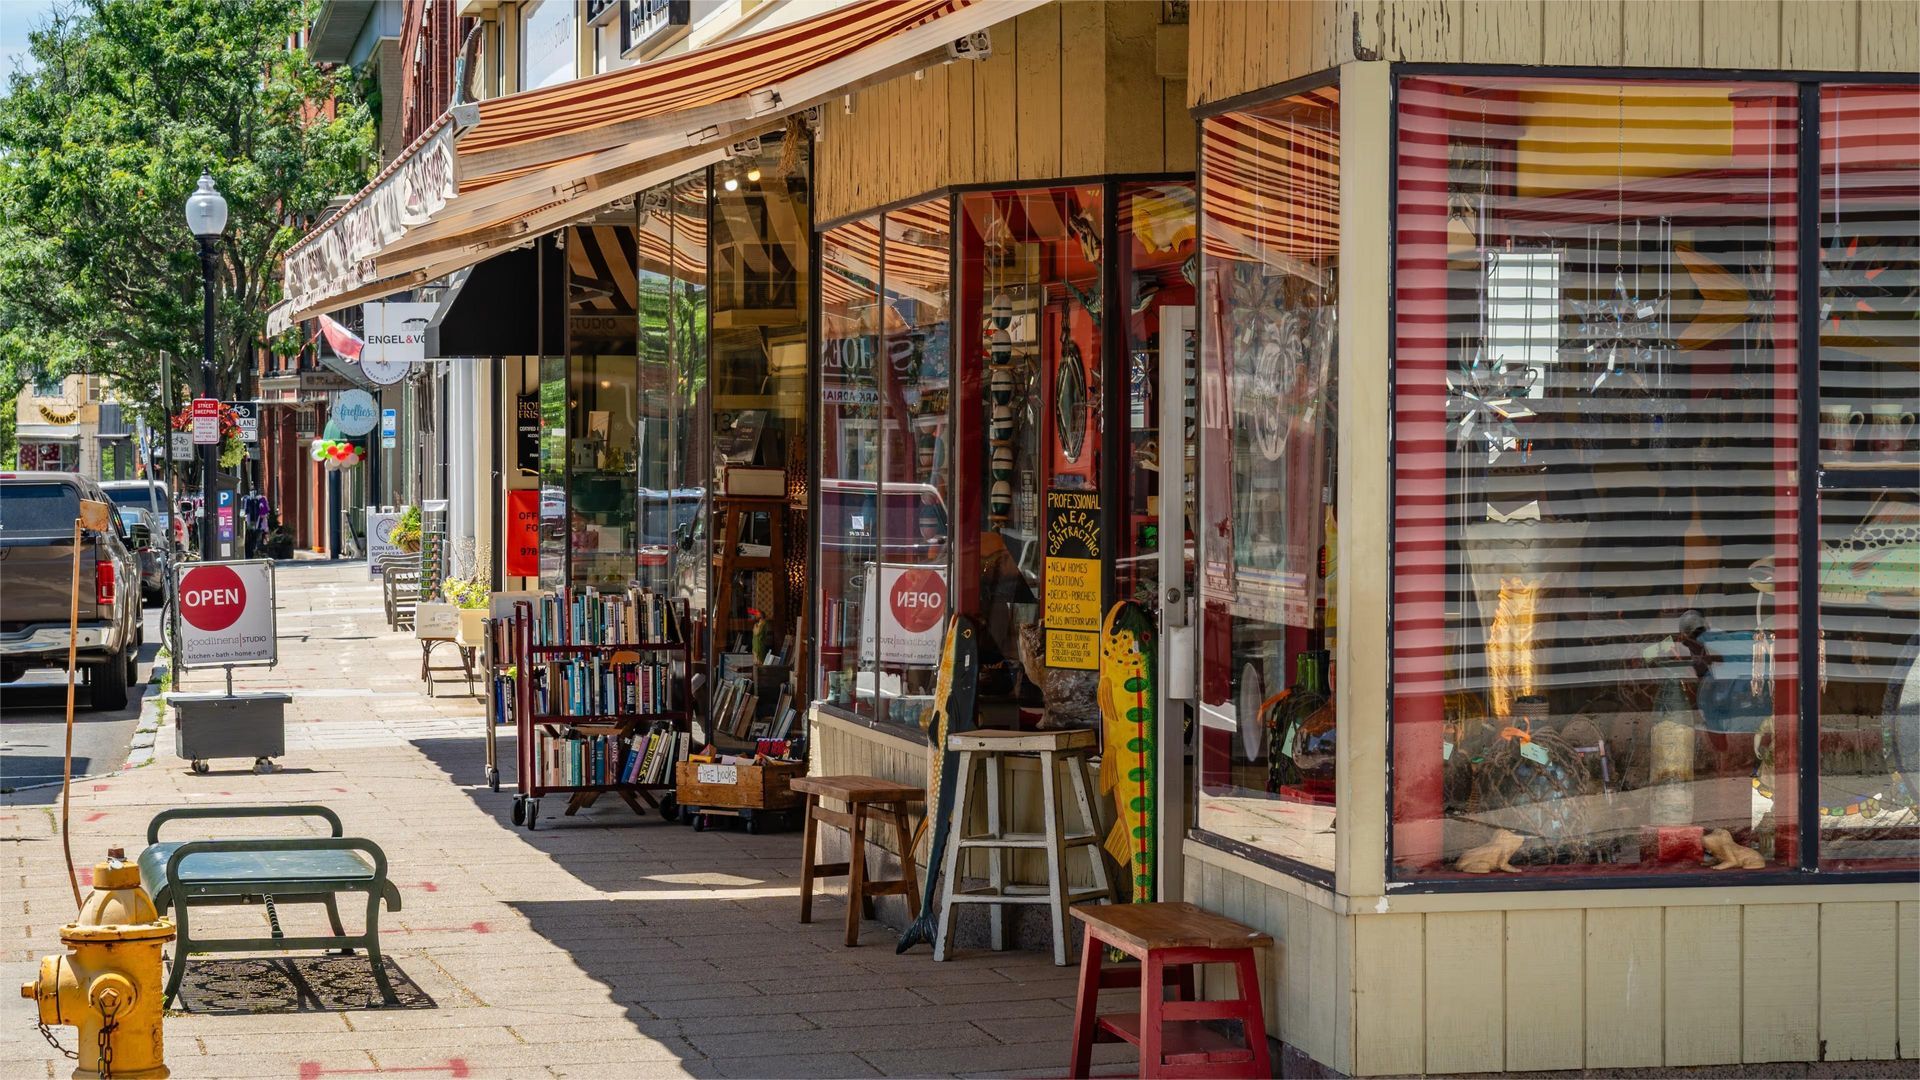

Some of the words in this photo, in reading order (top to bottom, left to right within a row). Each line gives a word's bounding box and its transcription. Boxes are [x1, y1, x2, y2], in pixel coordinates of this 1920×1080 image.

[40, 406, 76, 425] BANANAS
[220, 492, 229, 504] P
[1048, 492, 1101, 510] PROFESSIONAL
[1048, 510, 1100, 542] GENERAL
[1050, 526, 1099, 557] CONTRACTING
[1051, 562, 1066, 574] NEW
[1068, 562, 1088, 574] HOMES
[1051, 576, 1084, 588] ADDITIONS
[185, 588, 239, 607] OPEN
[1050, 589, 1068, 599] DECKS
[1072, 591, 1096, 601] PORCHES
[1050, 602, 1080, 614] GARAGES
[1050, 615, 1063, 626] PLUS
[1064, 616, 1084, 626] INTERIOR
[1085, 617, 1098, 626] WORK
